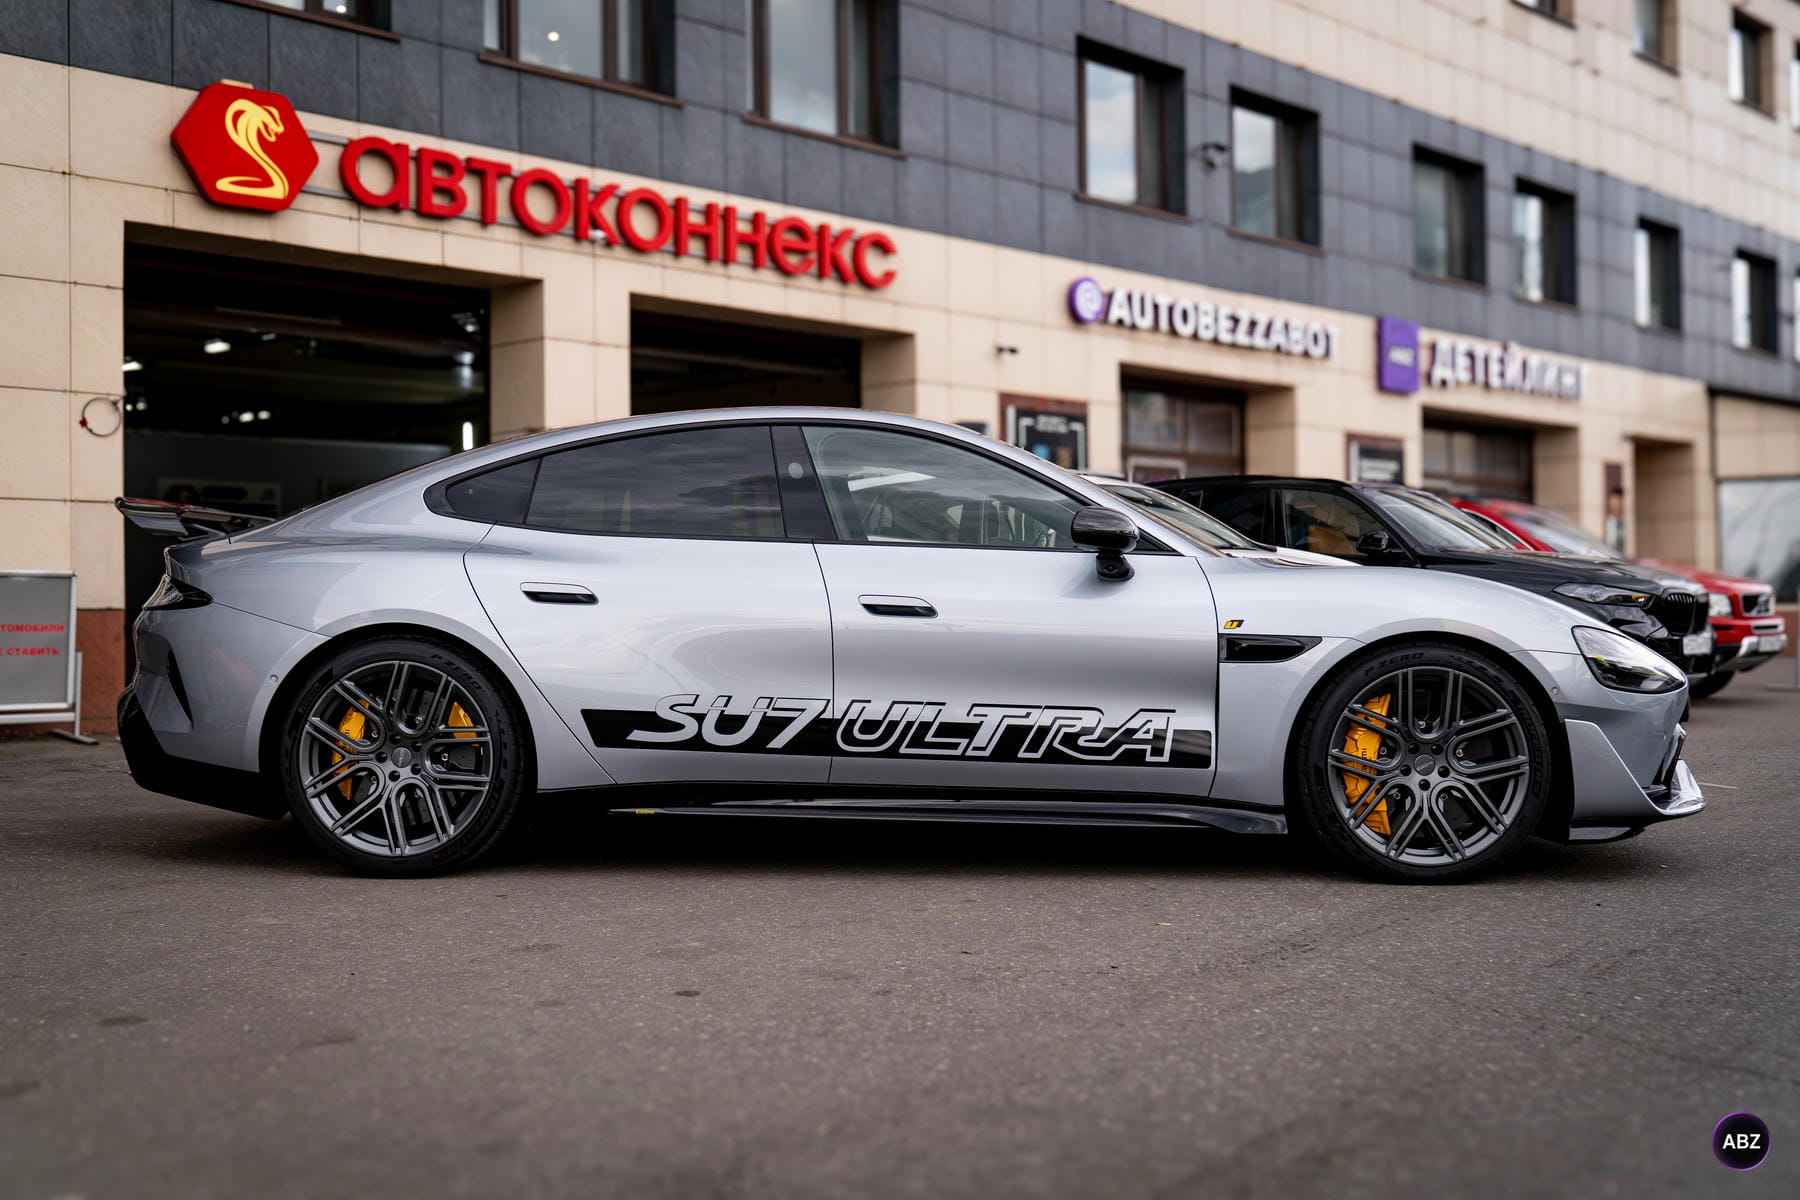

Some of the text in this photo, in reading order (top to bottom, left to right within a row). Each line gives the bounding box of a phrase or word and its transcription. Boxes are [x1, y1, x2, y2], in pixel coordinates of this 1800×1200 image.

[1107, 288, 1340, 359] AUTOBEZZABOT
[6, 647, 59, 656] СТАВИТЬ
[626, 694, 1176, 762] SU7 ULTRA
